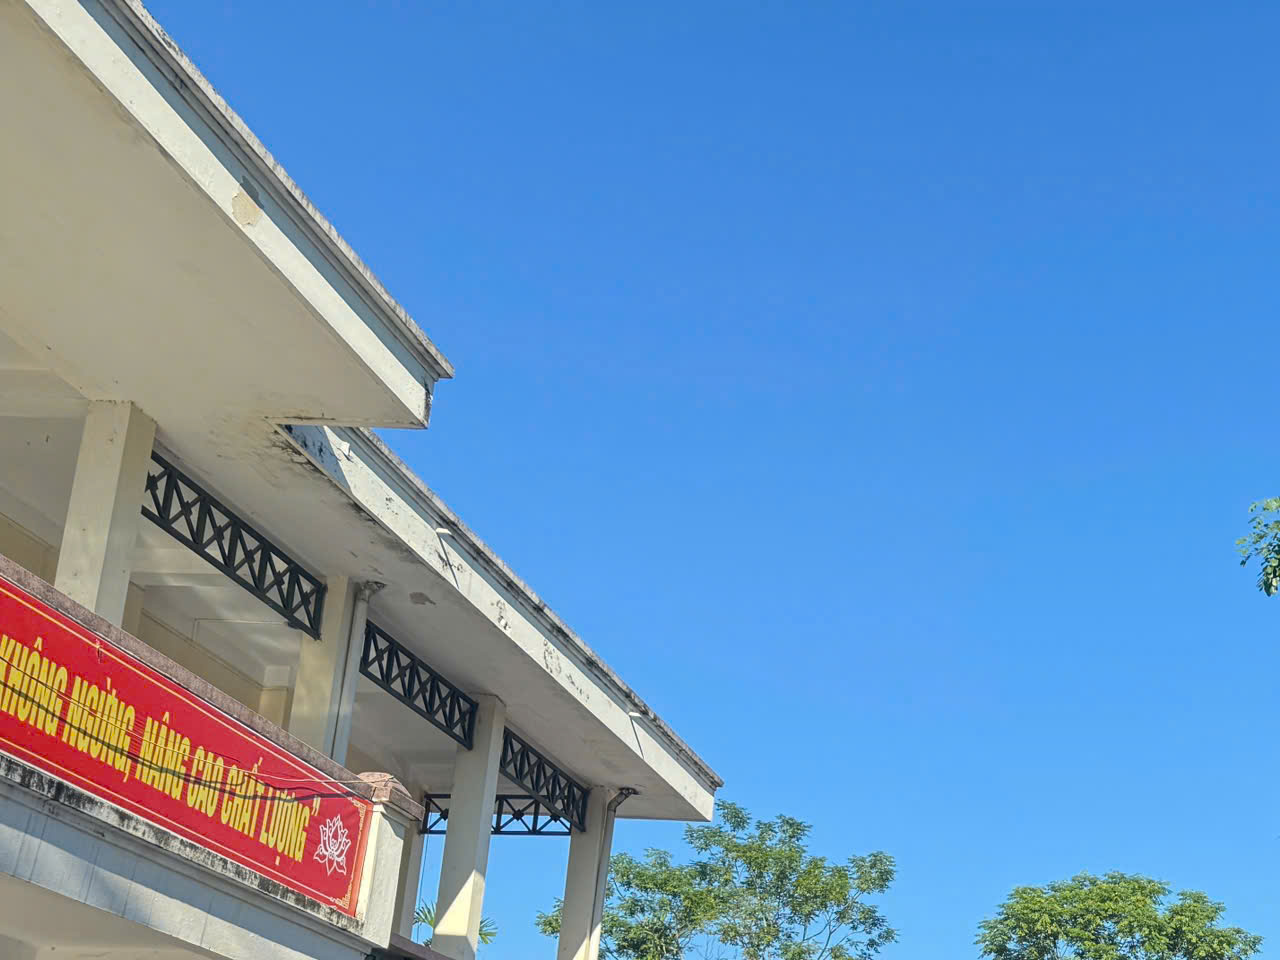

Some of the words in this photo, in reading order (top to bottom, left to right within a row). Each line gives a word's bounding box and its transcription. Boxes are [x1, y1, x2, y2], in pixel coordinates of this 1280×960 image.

[62, 676, 136, 782] NGỪNG,
[135, 711, 191, 801] NÂNG
[187, 746, 224, 818] CAO
[221, 757, 265, 839] CHẤT
